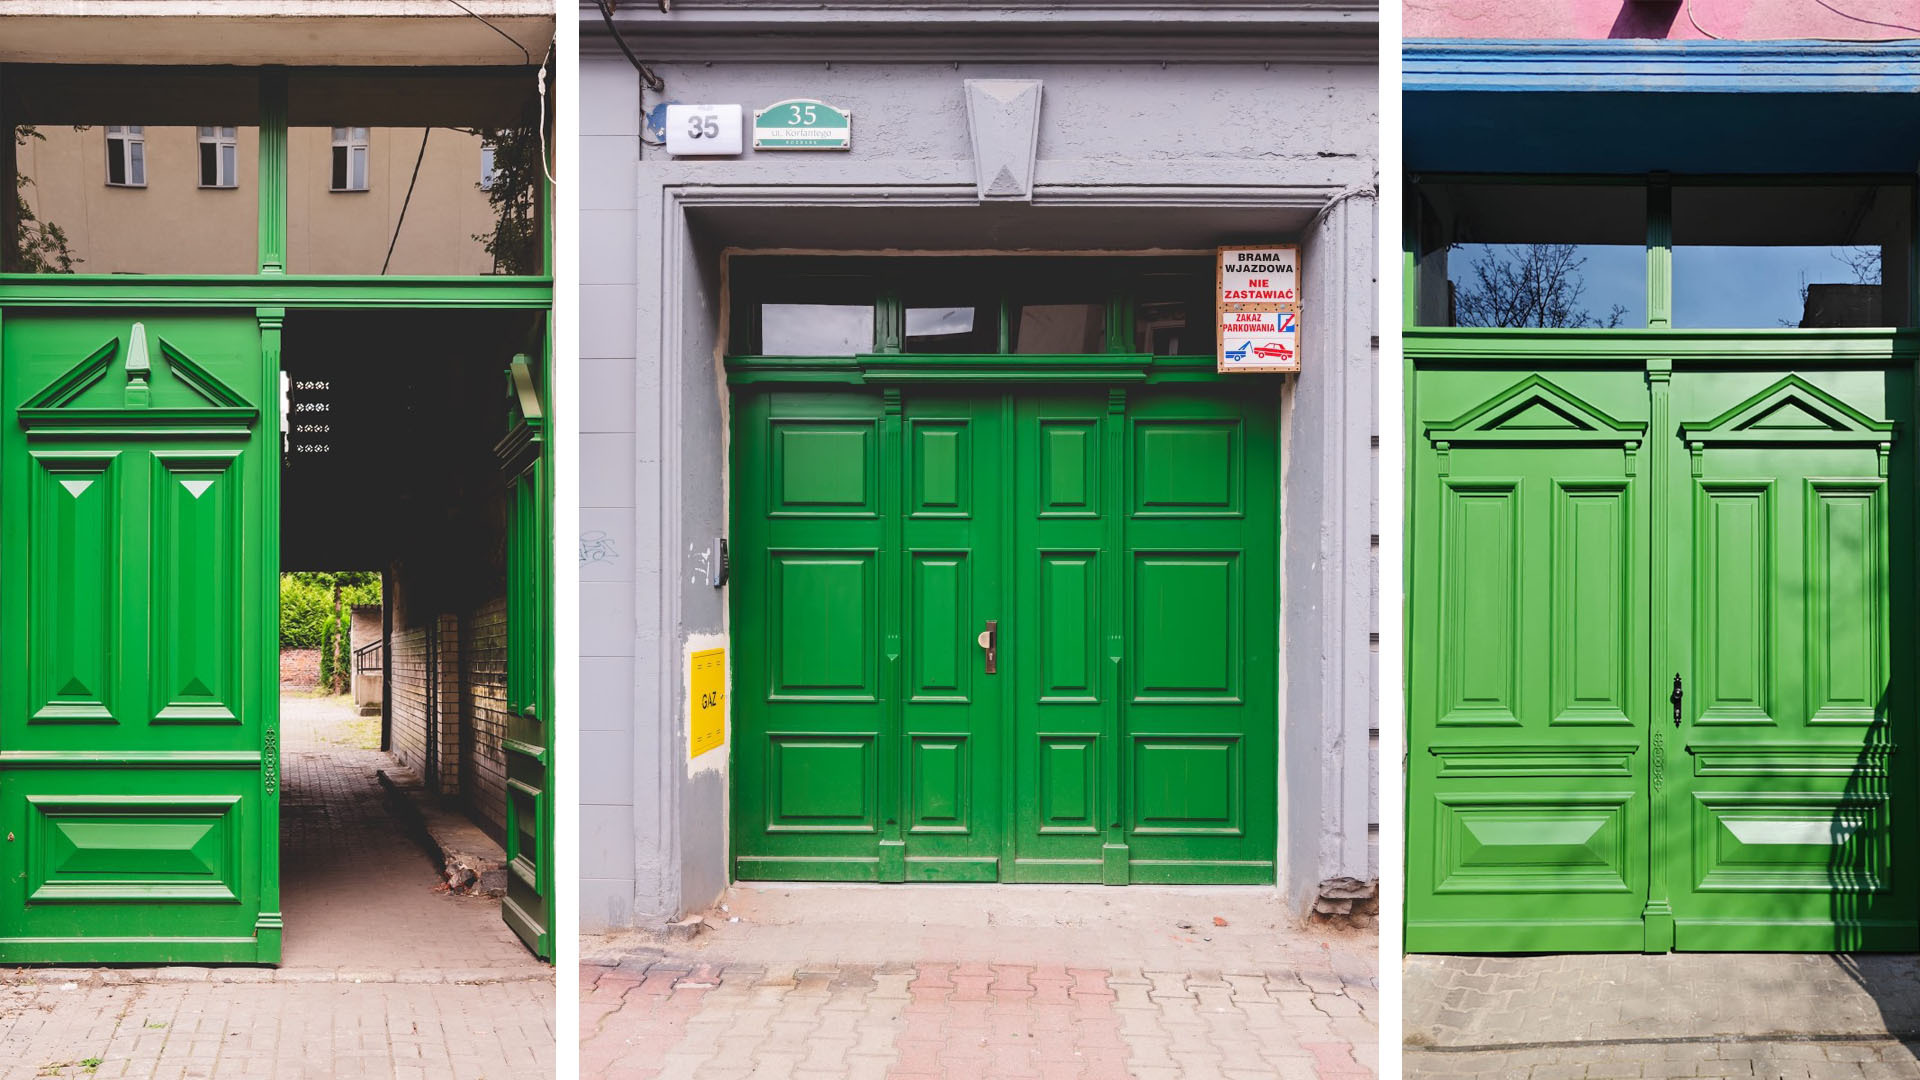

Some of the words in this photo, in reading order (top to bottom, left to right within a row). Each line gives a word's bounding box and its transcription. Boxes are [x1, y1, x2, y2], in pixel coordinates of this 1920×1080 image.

[787, 105, 817, 125] 35
[687, 115, 719, 139] 35
[785, 129, 832, 138] Korfantego
[1238, 253, 1280, 262] BRAMA
[1225, 264, 1293, 273] WJAZDOWA
[1248, 279, 1269, 288] NIE
[1224, 289, 1293, 299] ZASTAWIAĆ
[1236, 313, 1262, 322] ZAKAZ
[1222, 323, 1275, 332] PARKOWANIA
[702, 691, 717, 710] GAZ
